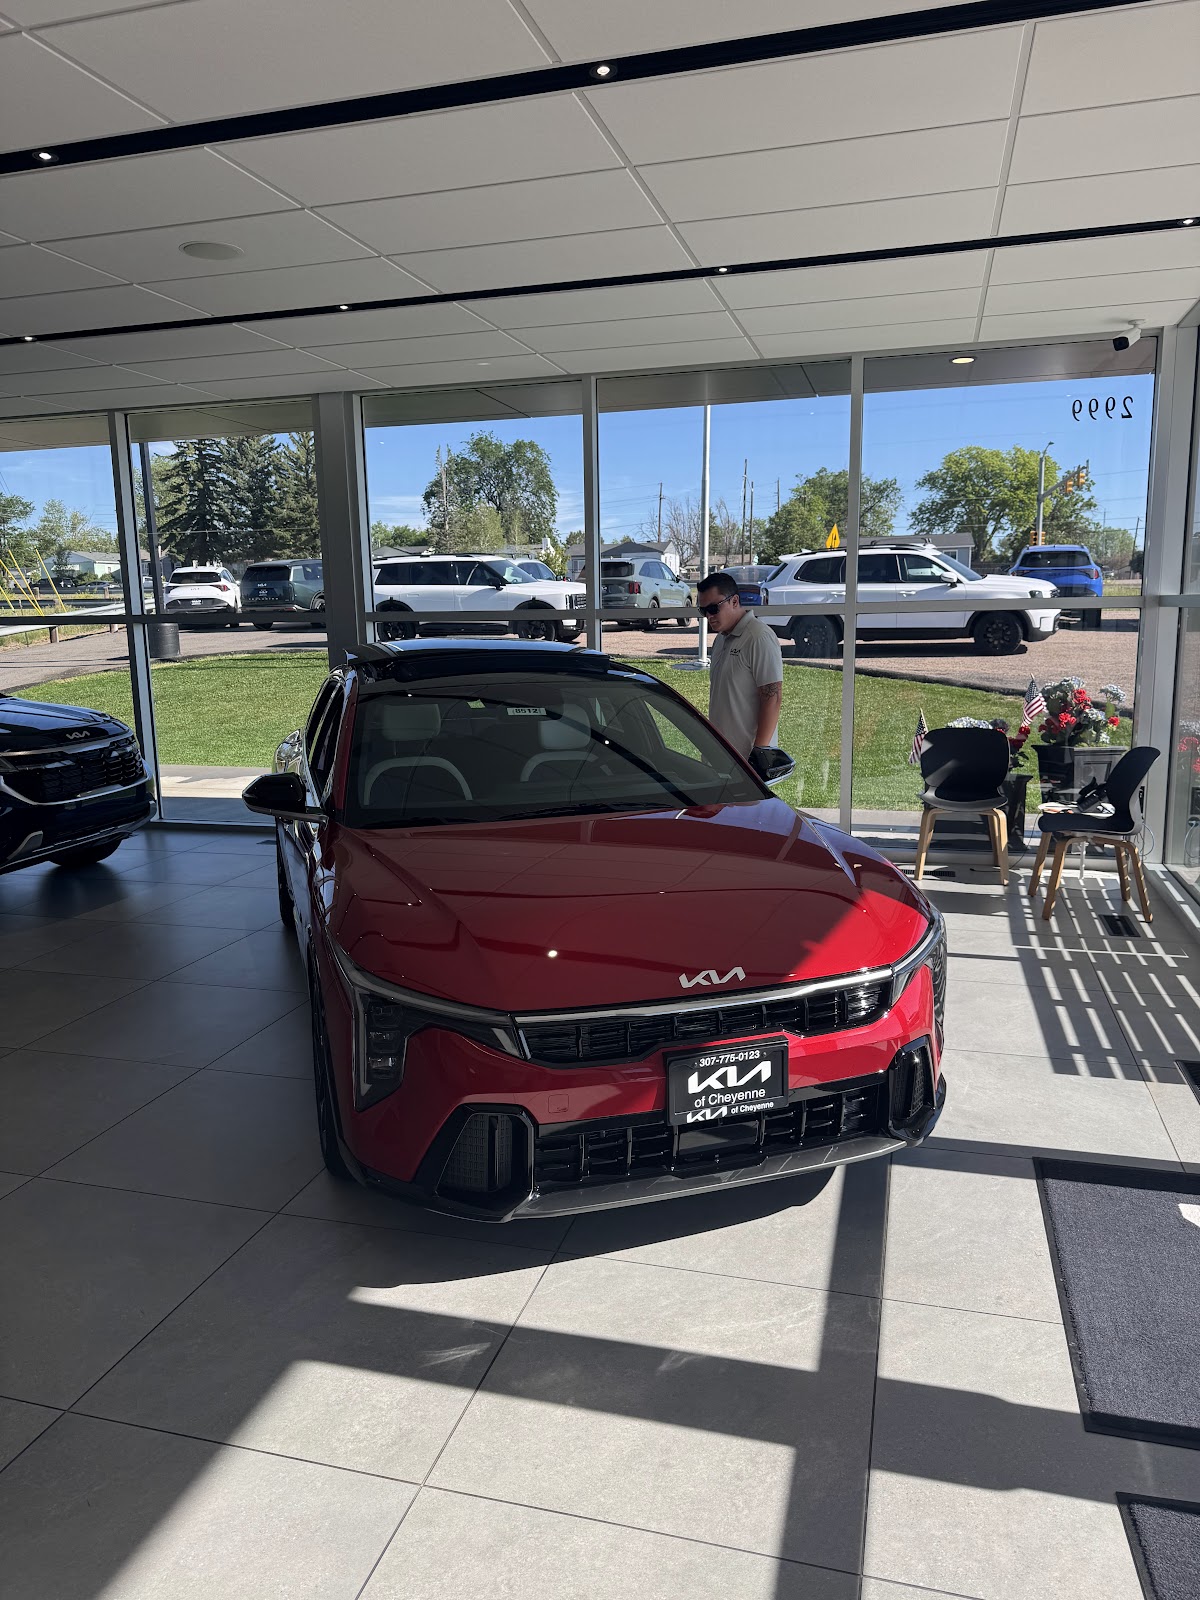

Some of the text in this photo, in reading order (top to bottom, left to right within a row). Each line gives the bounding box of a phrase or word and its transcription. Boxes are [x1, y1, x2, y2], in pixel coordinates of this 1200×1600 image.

[65, 730, 91, 740] KIA
[678, 966, 746, 989] KIA
[699, 1050, 760, 1067] 307-775-0123
[687, 1060, 772, 1094] KIA
[694, 1088, 766, 1108] of Cheyenne
[686, 1101, 774, 1123] KIA of Cheyenne
